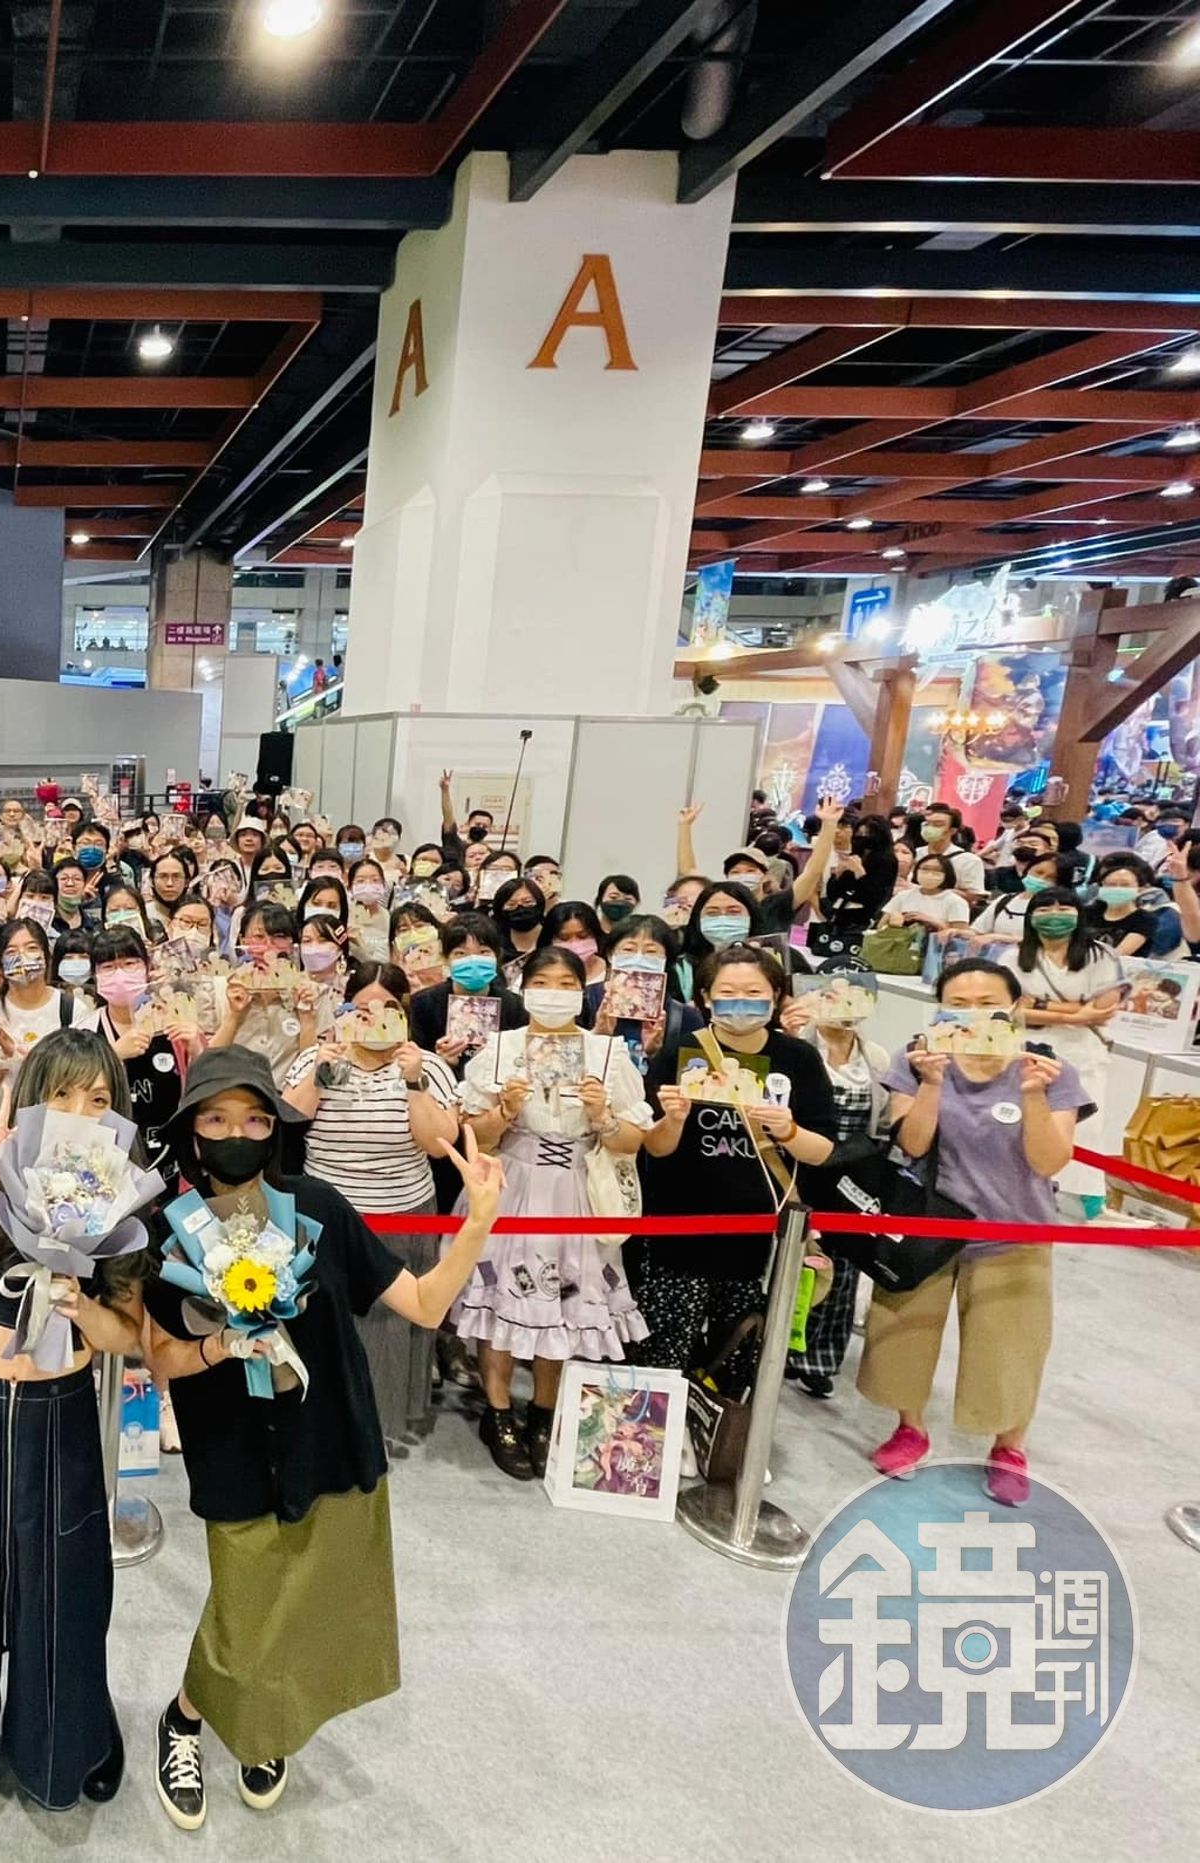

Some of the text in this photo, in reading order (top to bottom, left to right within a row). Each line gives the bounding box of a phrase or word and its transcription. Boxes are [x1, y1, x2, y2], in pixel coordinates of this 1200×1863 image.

[388, 299, 429, 418] A
[525, 253, 639, 371] A
[700, 1134, 758, 1159] SAKU
